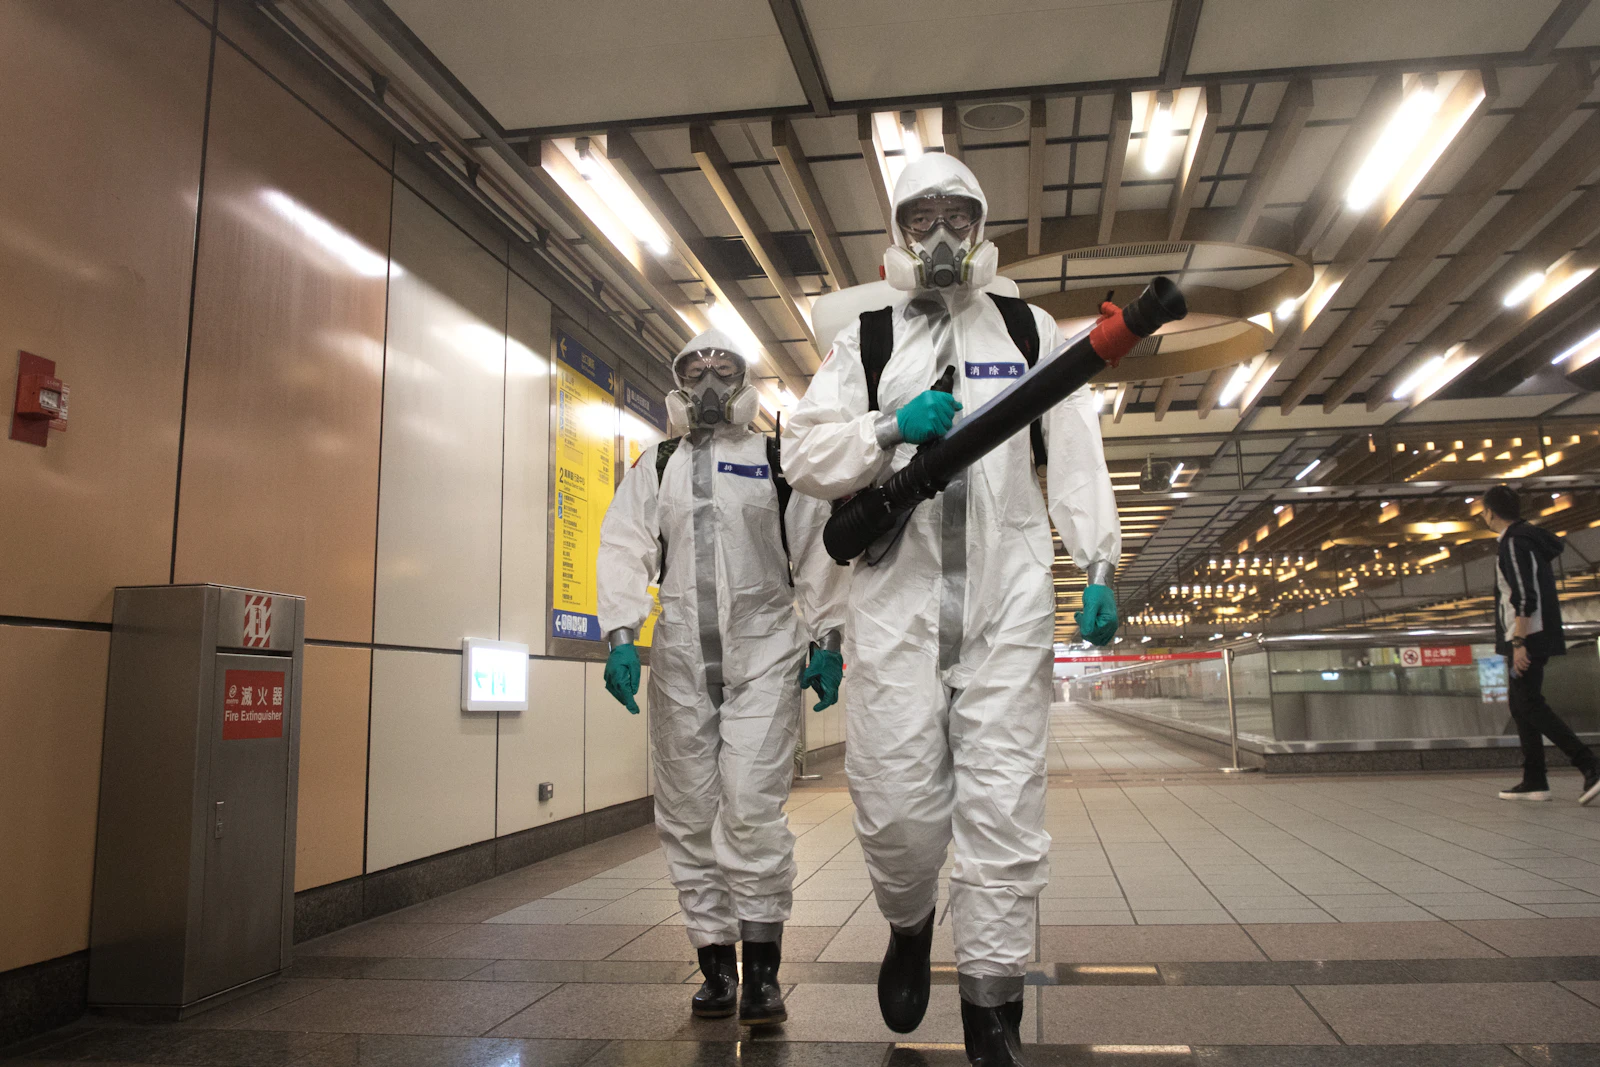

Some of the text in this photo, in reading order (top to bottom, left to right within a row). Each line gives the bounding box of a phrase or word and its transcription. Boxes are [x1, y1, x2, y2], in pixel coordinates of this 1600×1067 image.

[970, 365, 1019, 376] 消除兵
[559, 466, 564, 483] 2
[241, 686, 283, 706] 滅火器
[224, 710, 283, 724] Fire Extinguisher
